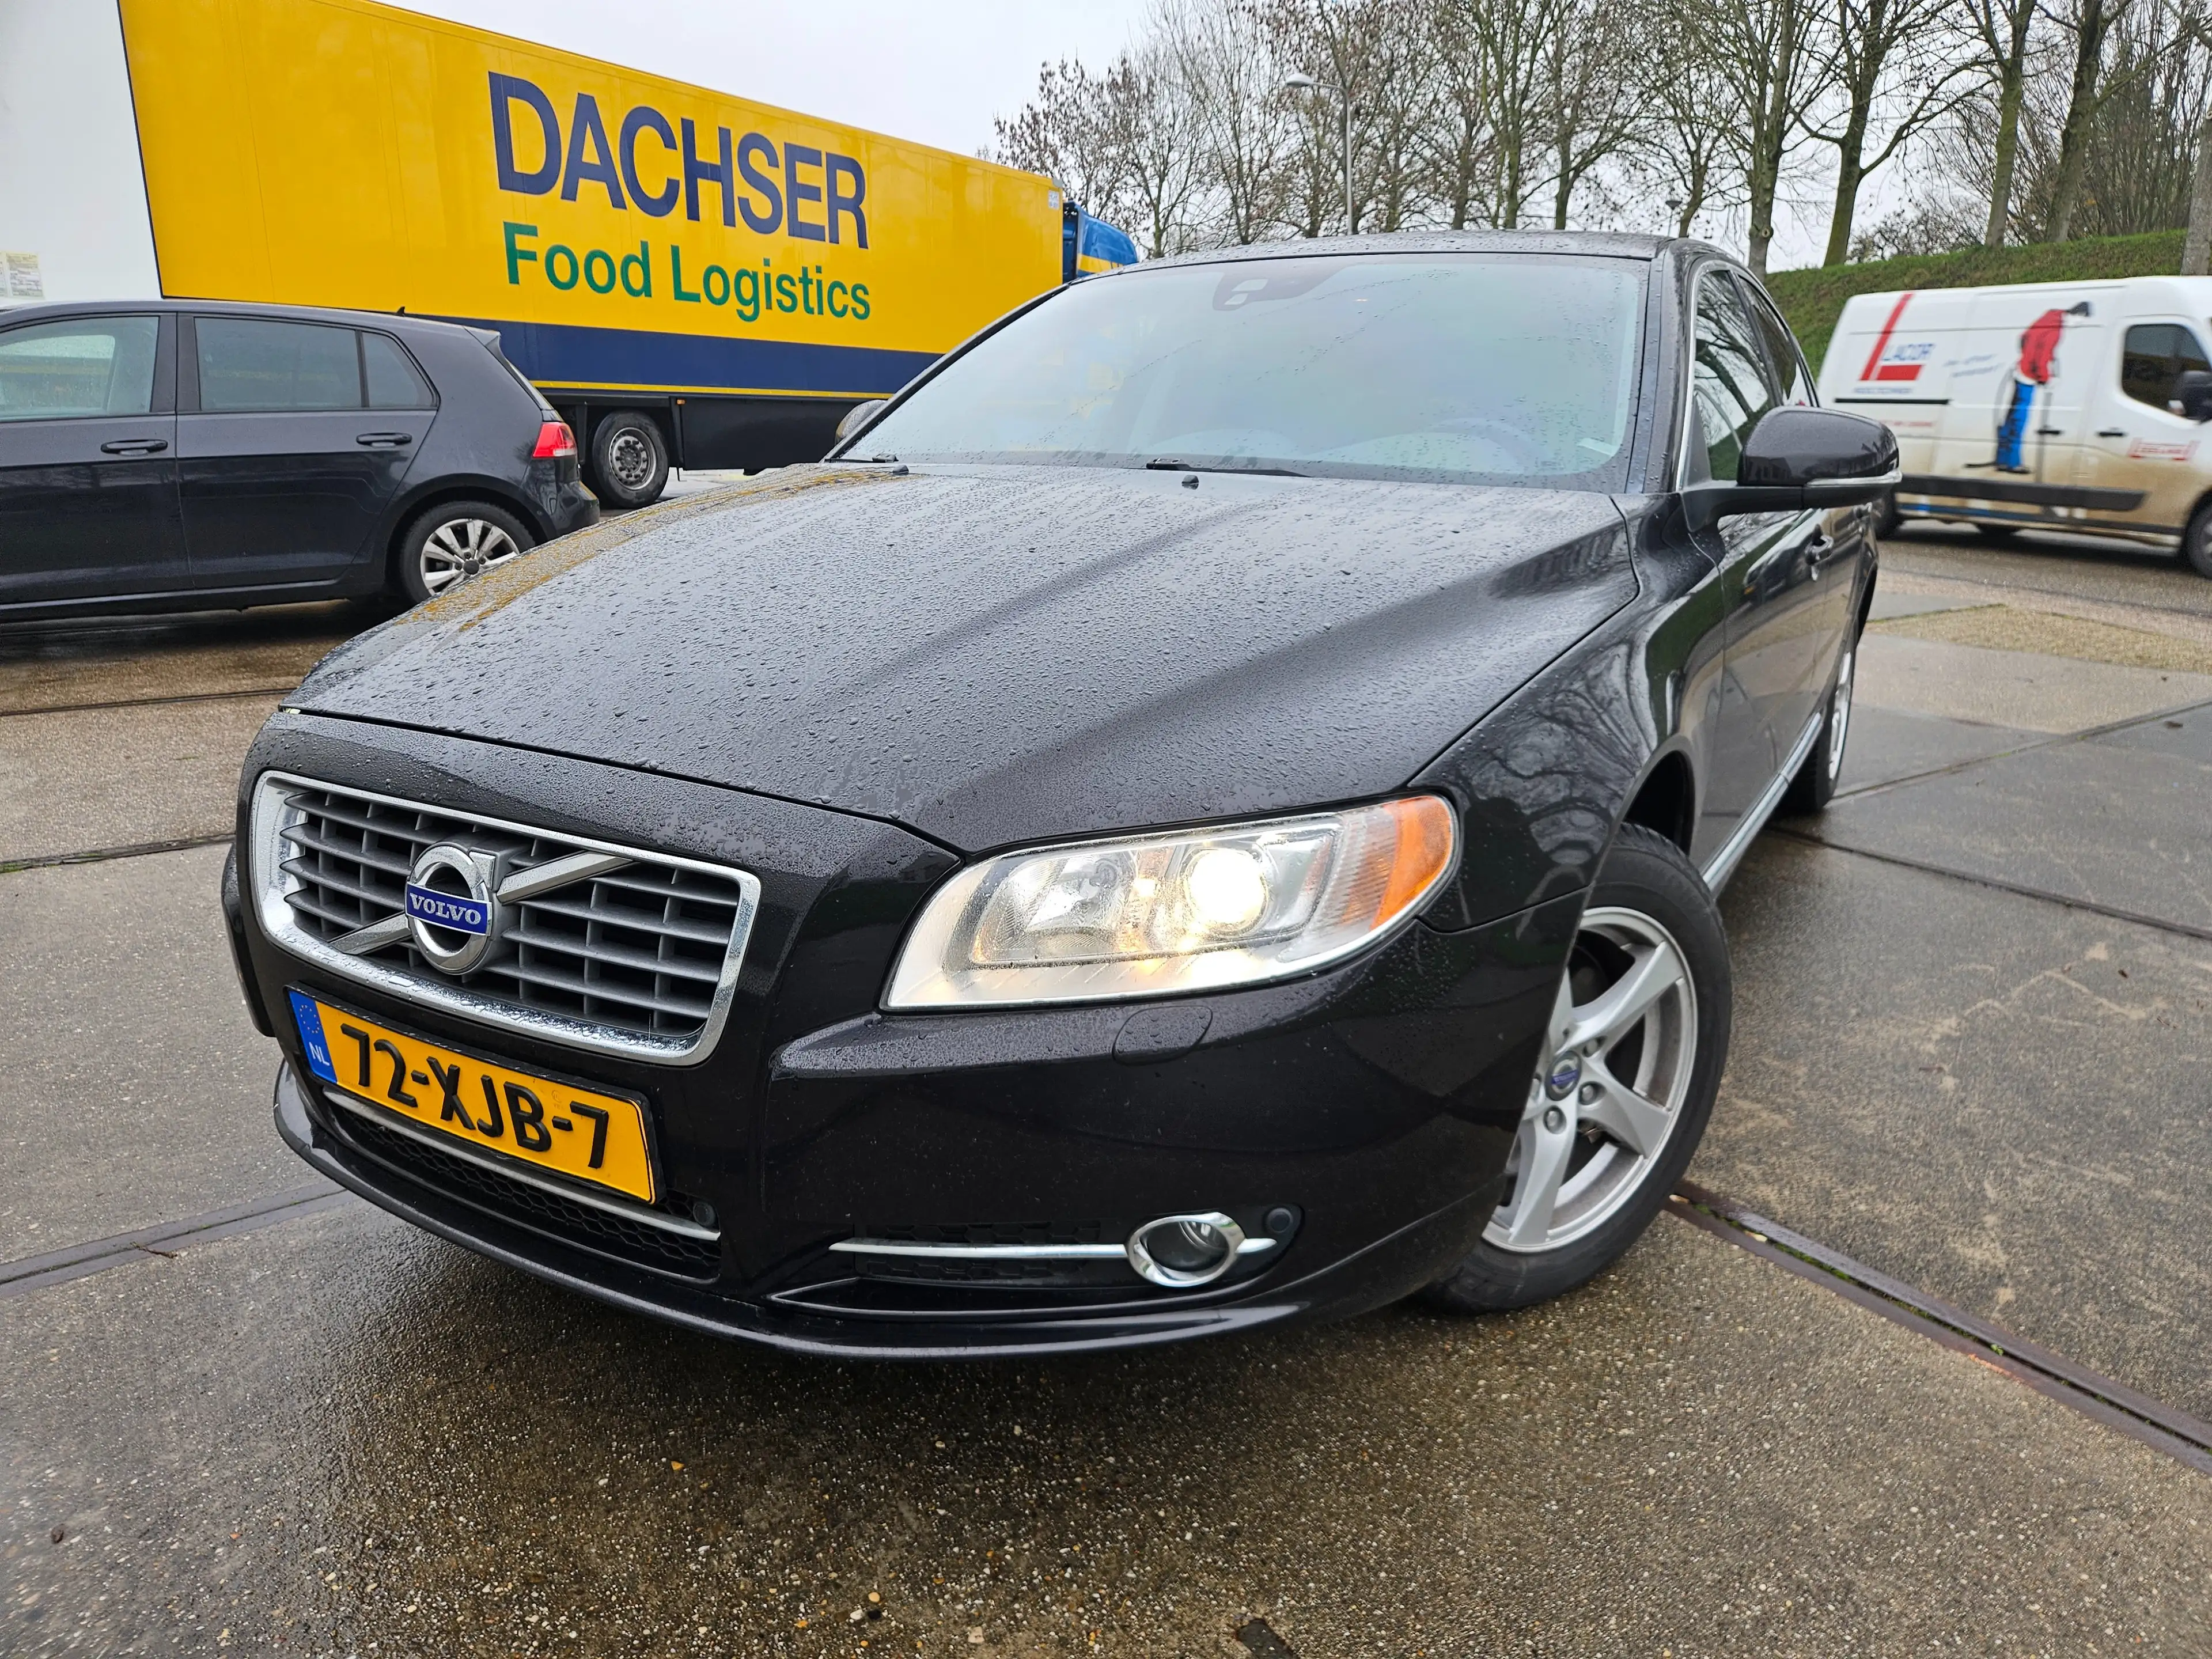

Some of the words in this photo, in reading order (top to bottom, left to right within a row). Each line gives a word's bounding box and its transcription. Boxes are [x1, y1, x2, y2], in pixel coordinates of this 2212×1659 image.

[488, 70, 869, 249] DACHSER
[503, 221, 652, 298] Food
[671, 244, 871, 323] Logistics
[410, 892, 482, 925] VOLVO
[309, 1041, 330, 1066] NL
[340, 1022, 609, 1169] 72-XJB-7
